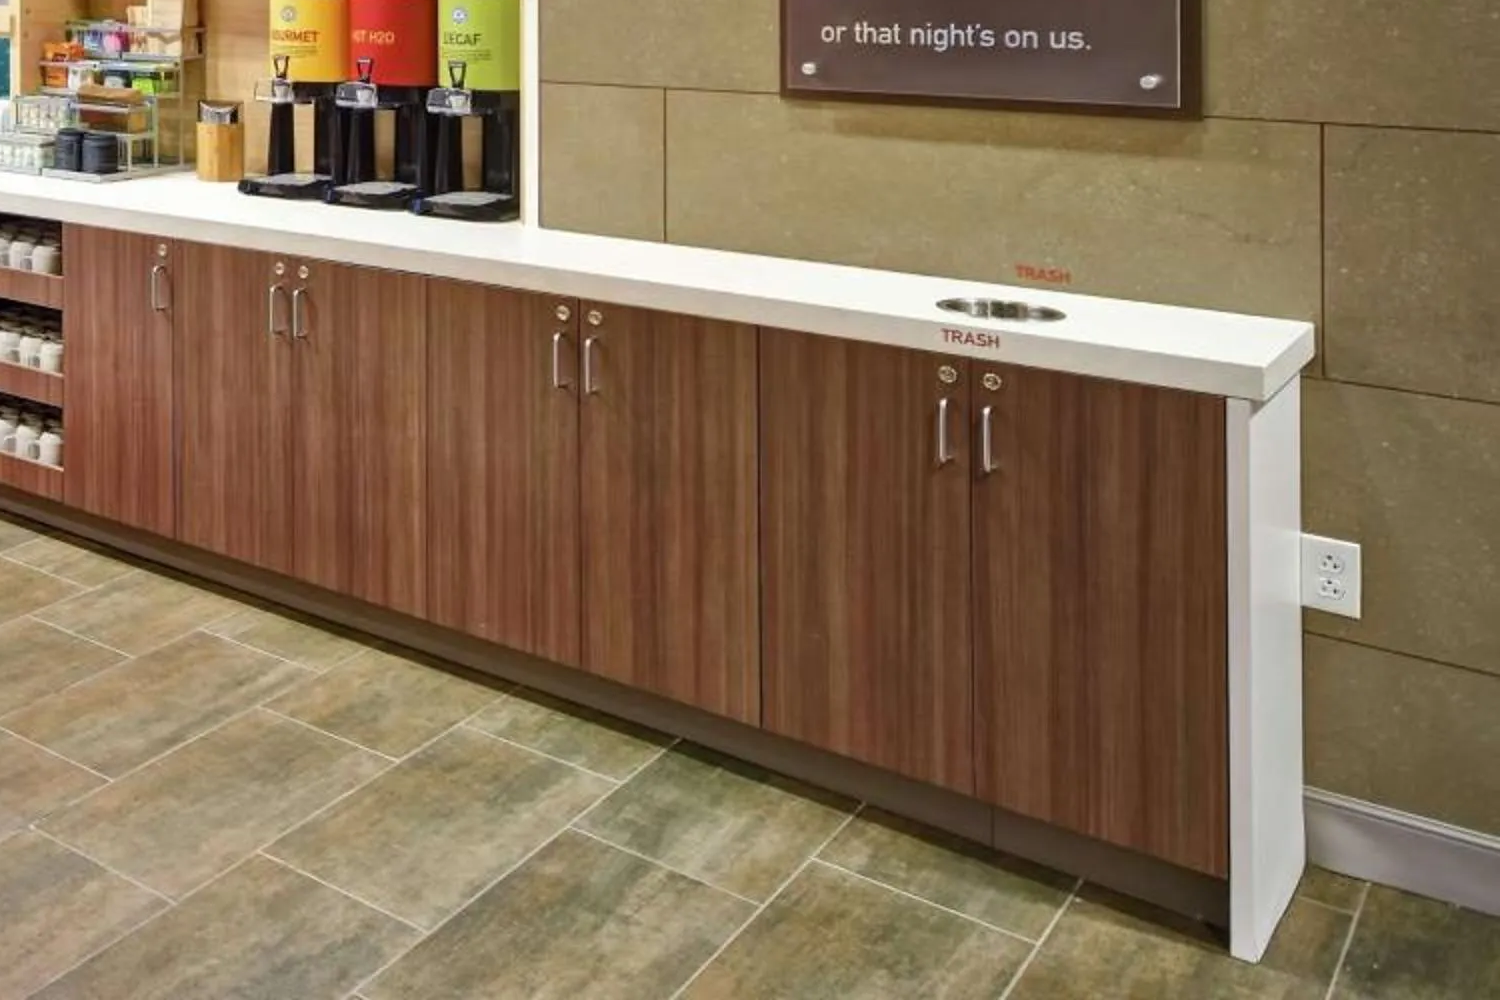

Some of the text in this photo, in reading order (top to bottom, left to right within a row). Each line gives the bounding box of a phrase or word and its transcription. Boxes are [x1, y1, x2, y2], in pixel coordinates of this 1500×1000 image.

[820, 20, 1092, 53] or that night's on us.
[1014, 263, 1073, 286] TRASH
[941, 327, 1000, 349] TRASH
